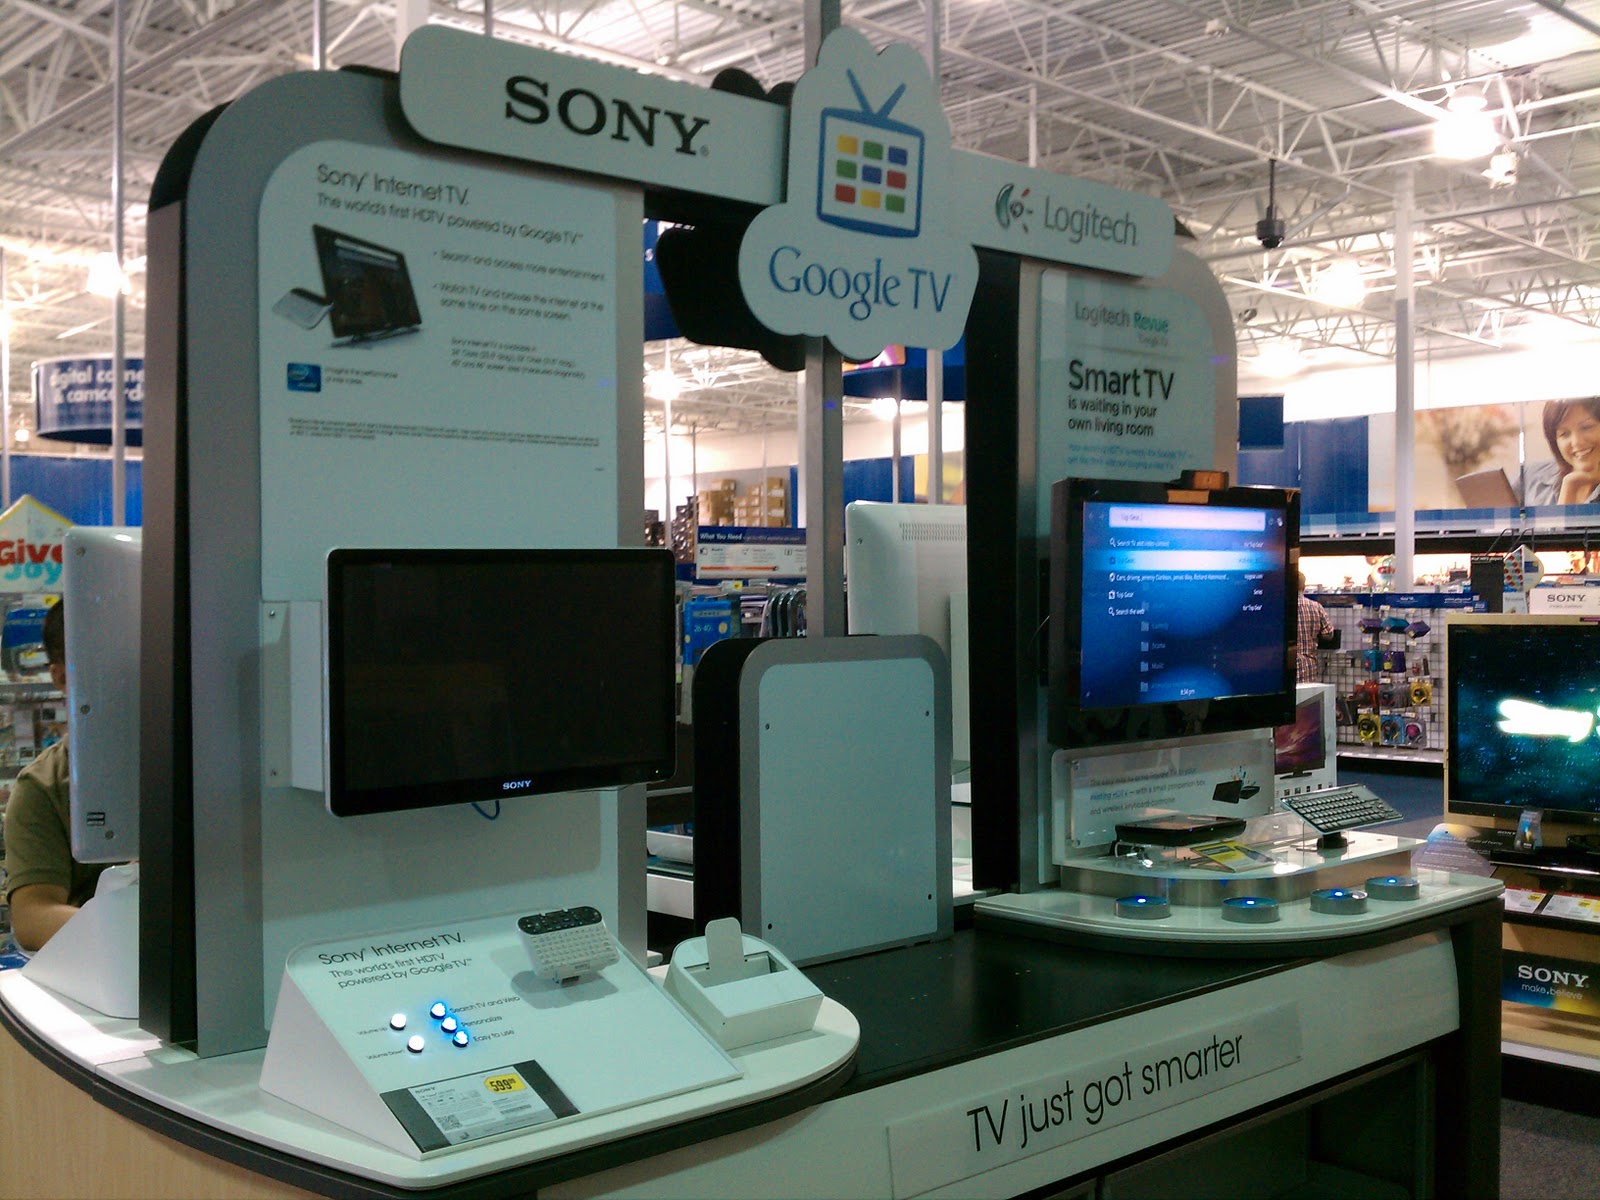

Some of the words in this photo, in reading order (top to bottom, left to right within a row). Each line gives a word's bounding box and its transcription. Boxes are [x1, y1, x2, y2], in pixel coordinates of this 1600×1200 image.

[505, 75, 710, 156] SONY
[1043, 196, 1138, 247] Logitech
[768, 245, 900, 321] Google
[908, 267, 952, 313] TV
[1075, 301, 1130, 328] Logitech
[1068, 395, 1077, 410] is
[1080, 398, 1120, 417] waiting
[1122, 401, 1131, 415] in
[1134, 405, 1158, 419] your
[1067, 418, 1092, 430] own
[1095, 416, 1123, 436] living
[1126, 424, 1154, 437] room
[1546, 594, 1586, 603] SONY
[502, 779, 532, 790] SONY
[318, 949, 365, 965] Sony
[329, 969, 353, 979] The
[354, 962, 394, 975] world's
[395, 958, 414, 967] first
[416, 952, 446, 965] HDTV
[338, 972, 392, 989] powered
[393, 970, 409, 979] by
[1517, 965, 1589, 988] SONY
[966, 1099, 1009, 1152] TV
[1021, 1080, 1074, 1149] just
[1083, 1061, 1133, 1125] got
[1142, 1034, 1244, 1095] smarter
